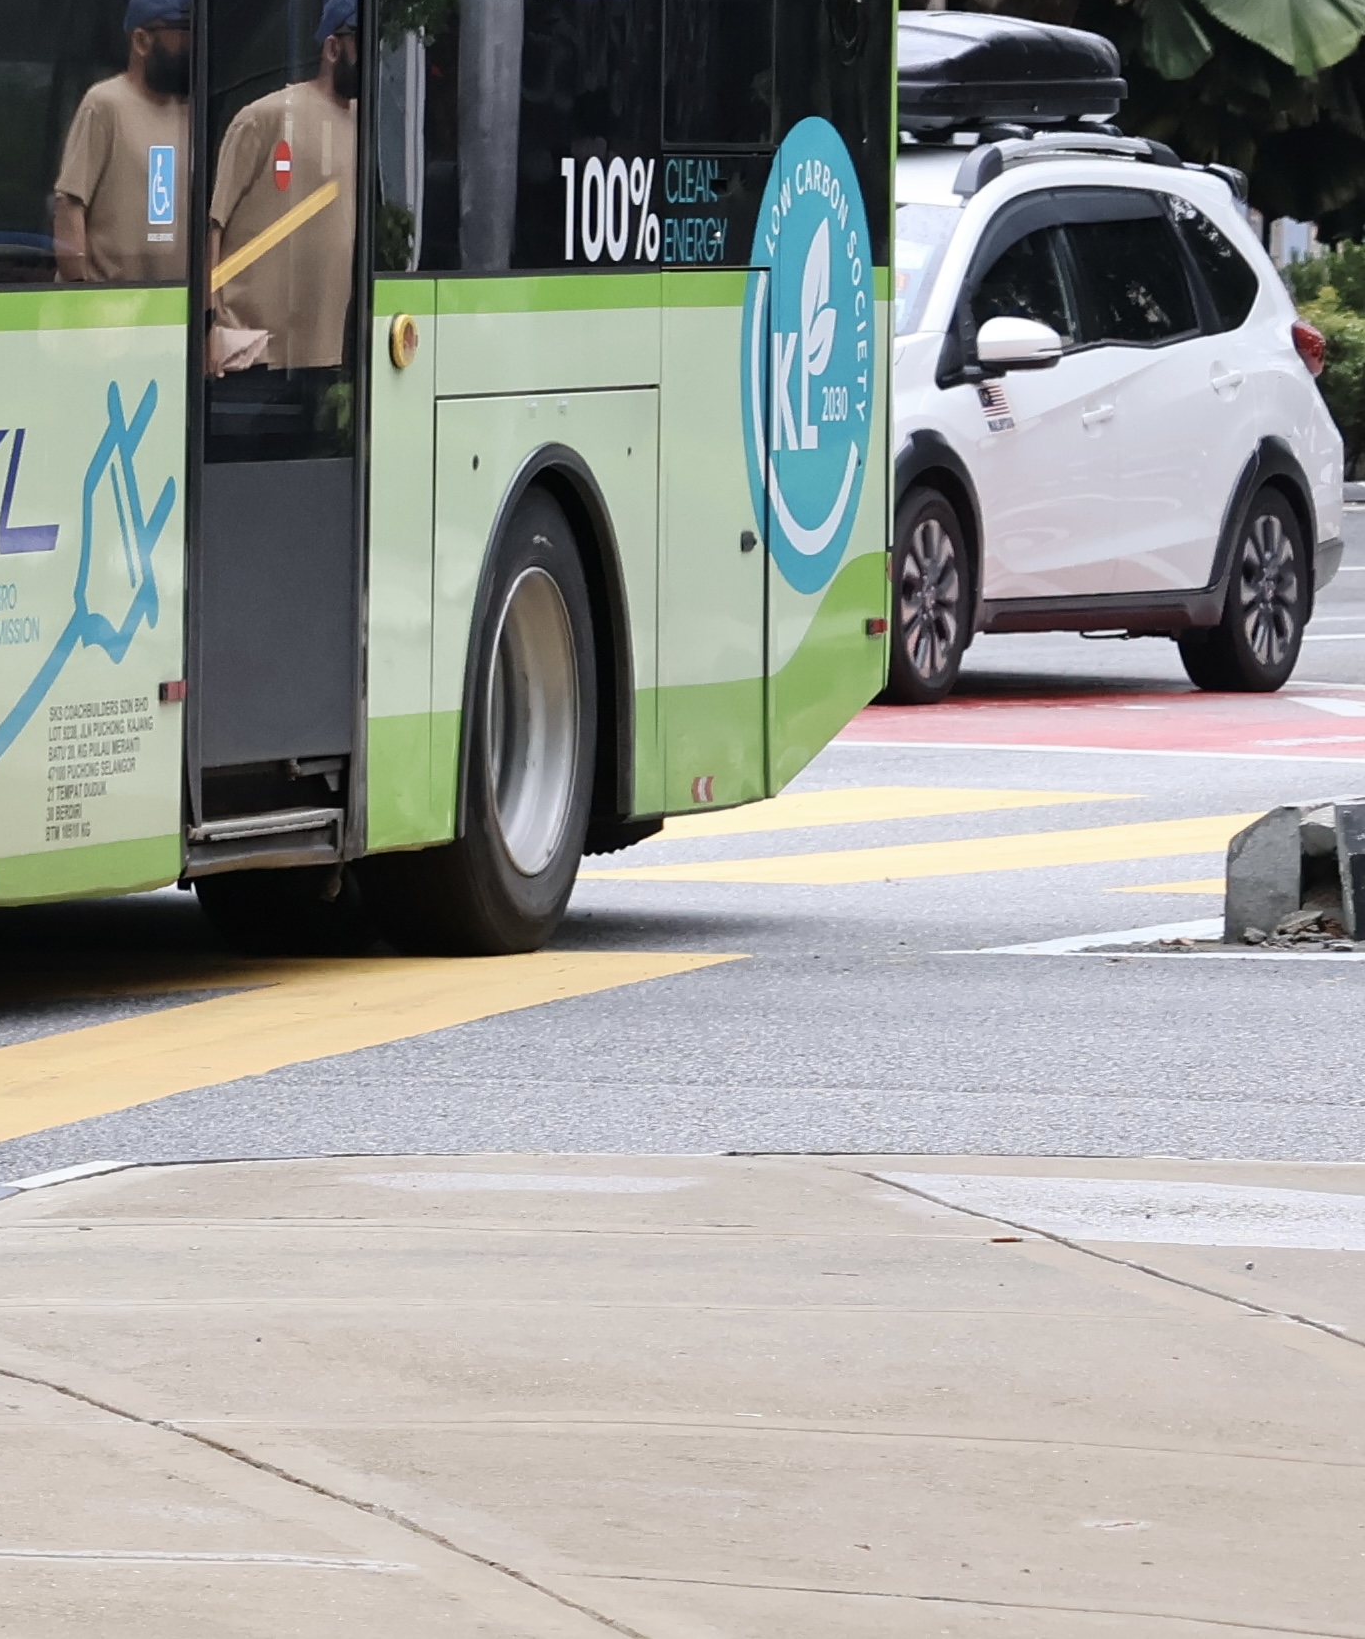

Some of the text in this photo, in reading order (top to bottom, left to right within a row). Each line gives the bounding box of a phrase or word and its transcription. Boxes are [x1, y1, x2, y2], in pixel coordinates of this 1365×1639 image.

[665, 159, 719, 204] CLEAN
[561, 156, 660, 262] 100%
[664, 217, 728, 262] ENERGY
[765, 159, 869, 422] LOW CARBON SOCIETY
[821, 385, 848, 422] 2030
